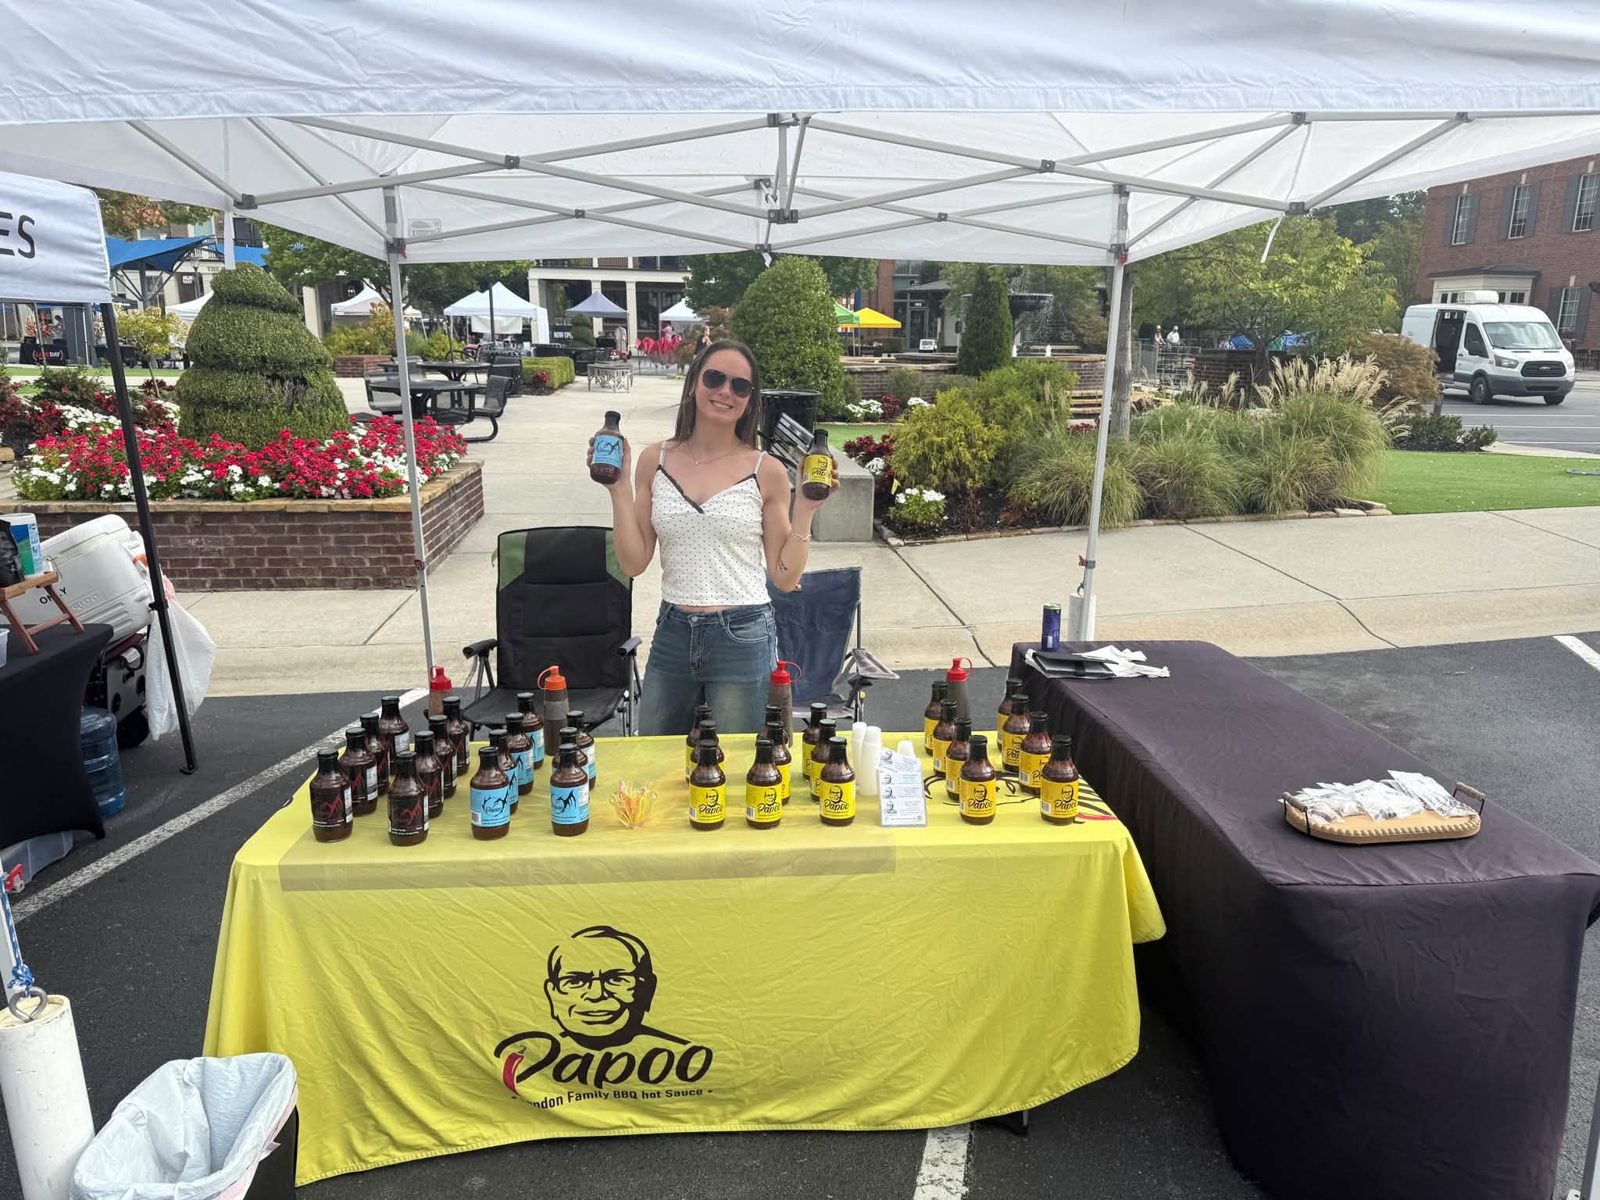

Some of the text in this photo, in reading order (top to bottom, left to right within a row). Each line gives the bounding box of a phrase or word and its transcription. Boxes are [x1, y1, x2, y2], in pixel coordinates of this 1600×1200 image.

[494, 1031, 713, 1096] Papoo
[567, 1091, 609, 1104] Family
[613, 1090, 638, 1099] BBQ
[641, 1090, 662, 1099] hot
[665, 1089, 703, 1098] Sauce
